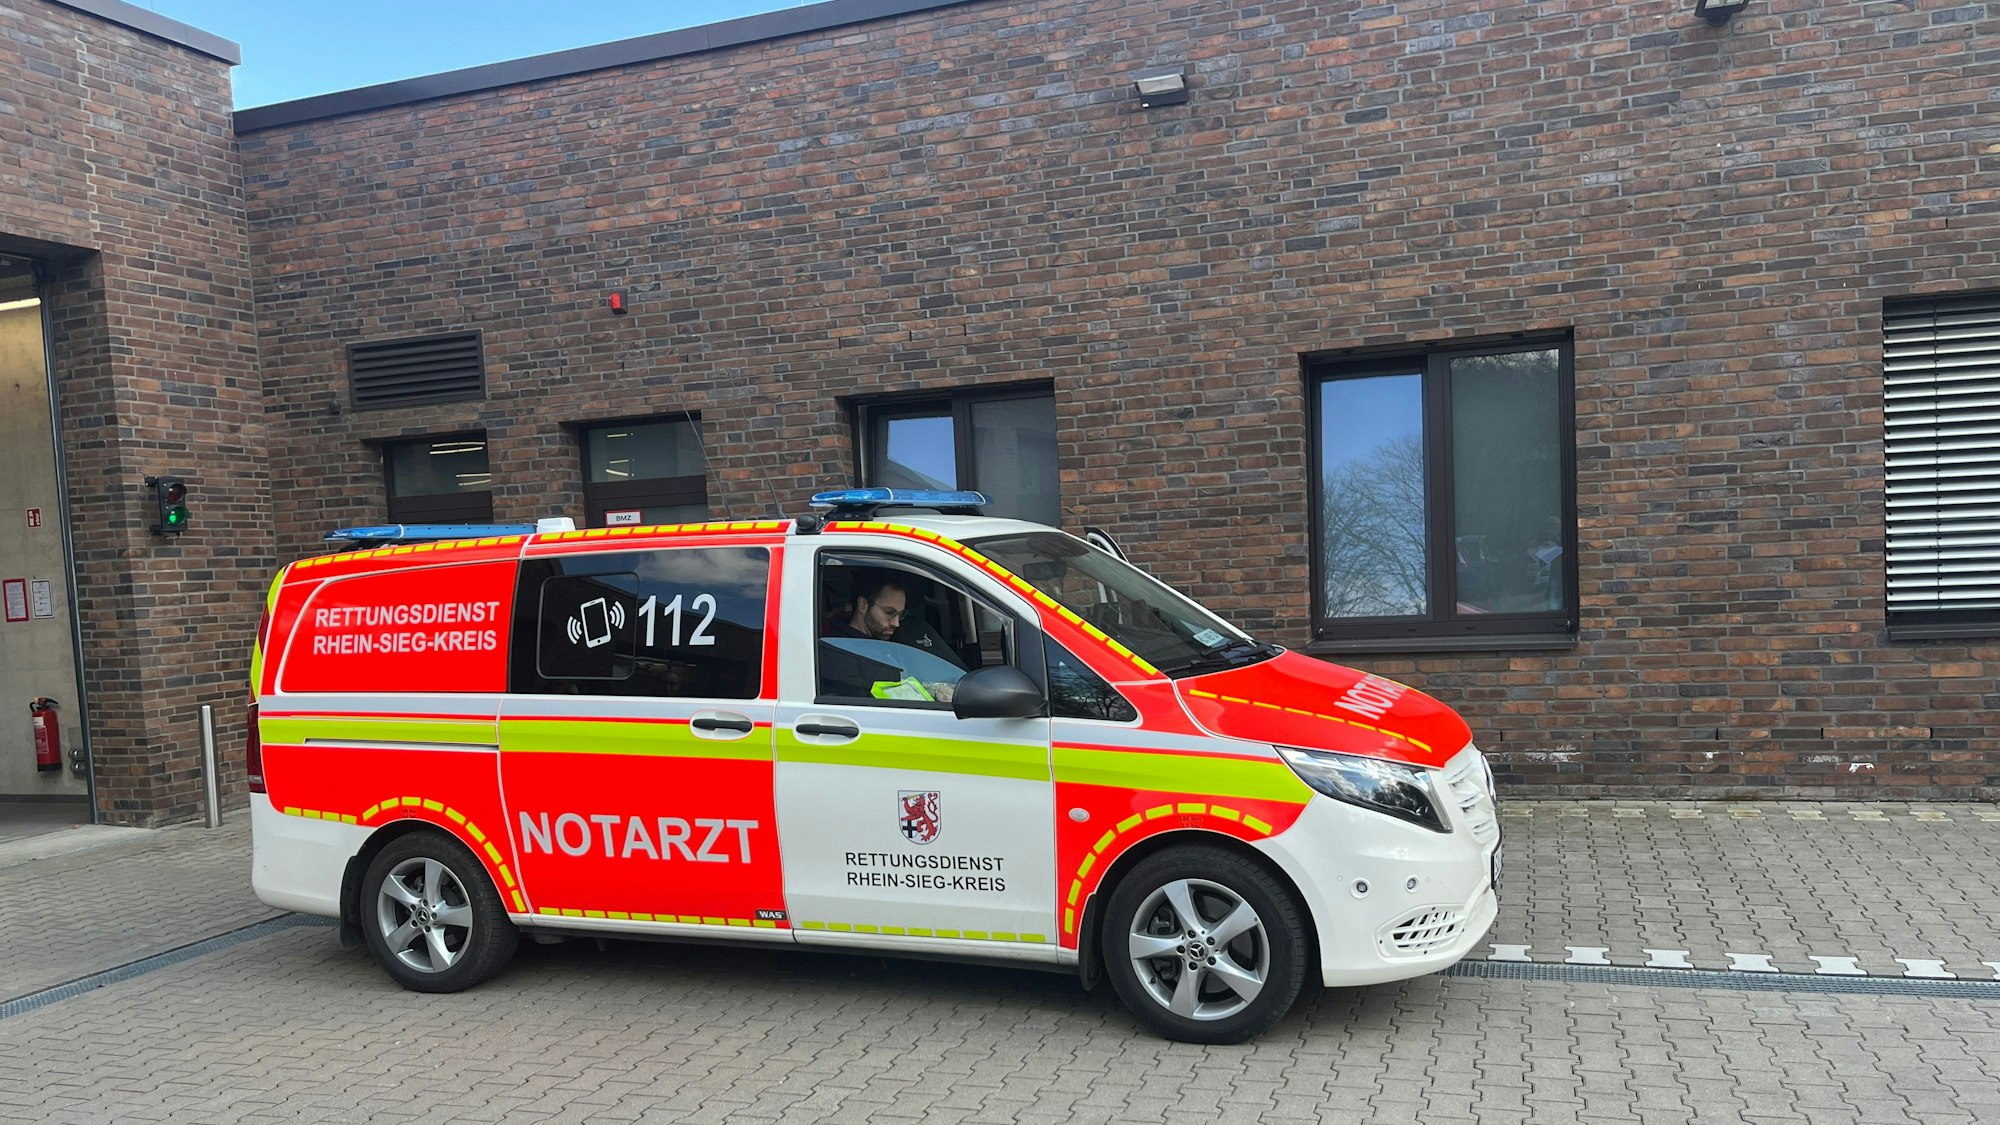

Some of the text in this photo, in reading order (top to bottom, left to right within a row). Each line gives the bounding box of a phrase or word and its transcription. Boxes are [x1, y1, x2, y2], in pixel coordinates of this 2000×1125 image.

[314, 601, 500, 628] RETTUNGSDIENST
[638, 593, 717, 647] 112
[313, 629, 497, 655] RHEIN-SIEG-KREIS
[518, 811, 759, 864] NOTARZT
[845, 852, 1004, 871] RETTUNGSDIENST
[847, 872, 1006, 892] RHEIN-SIEG-KREIS
[759, 911, 783, 919] WAS
